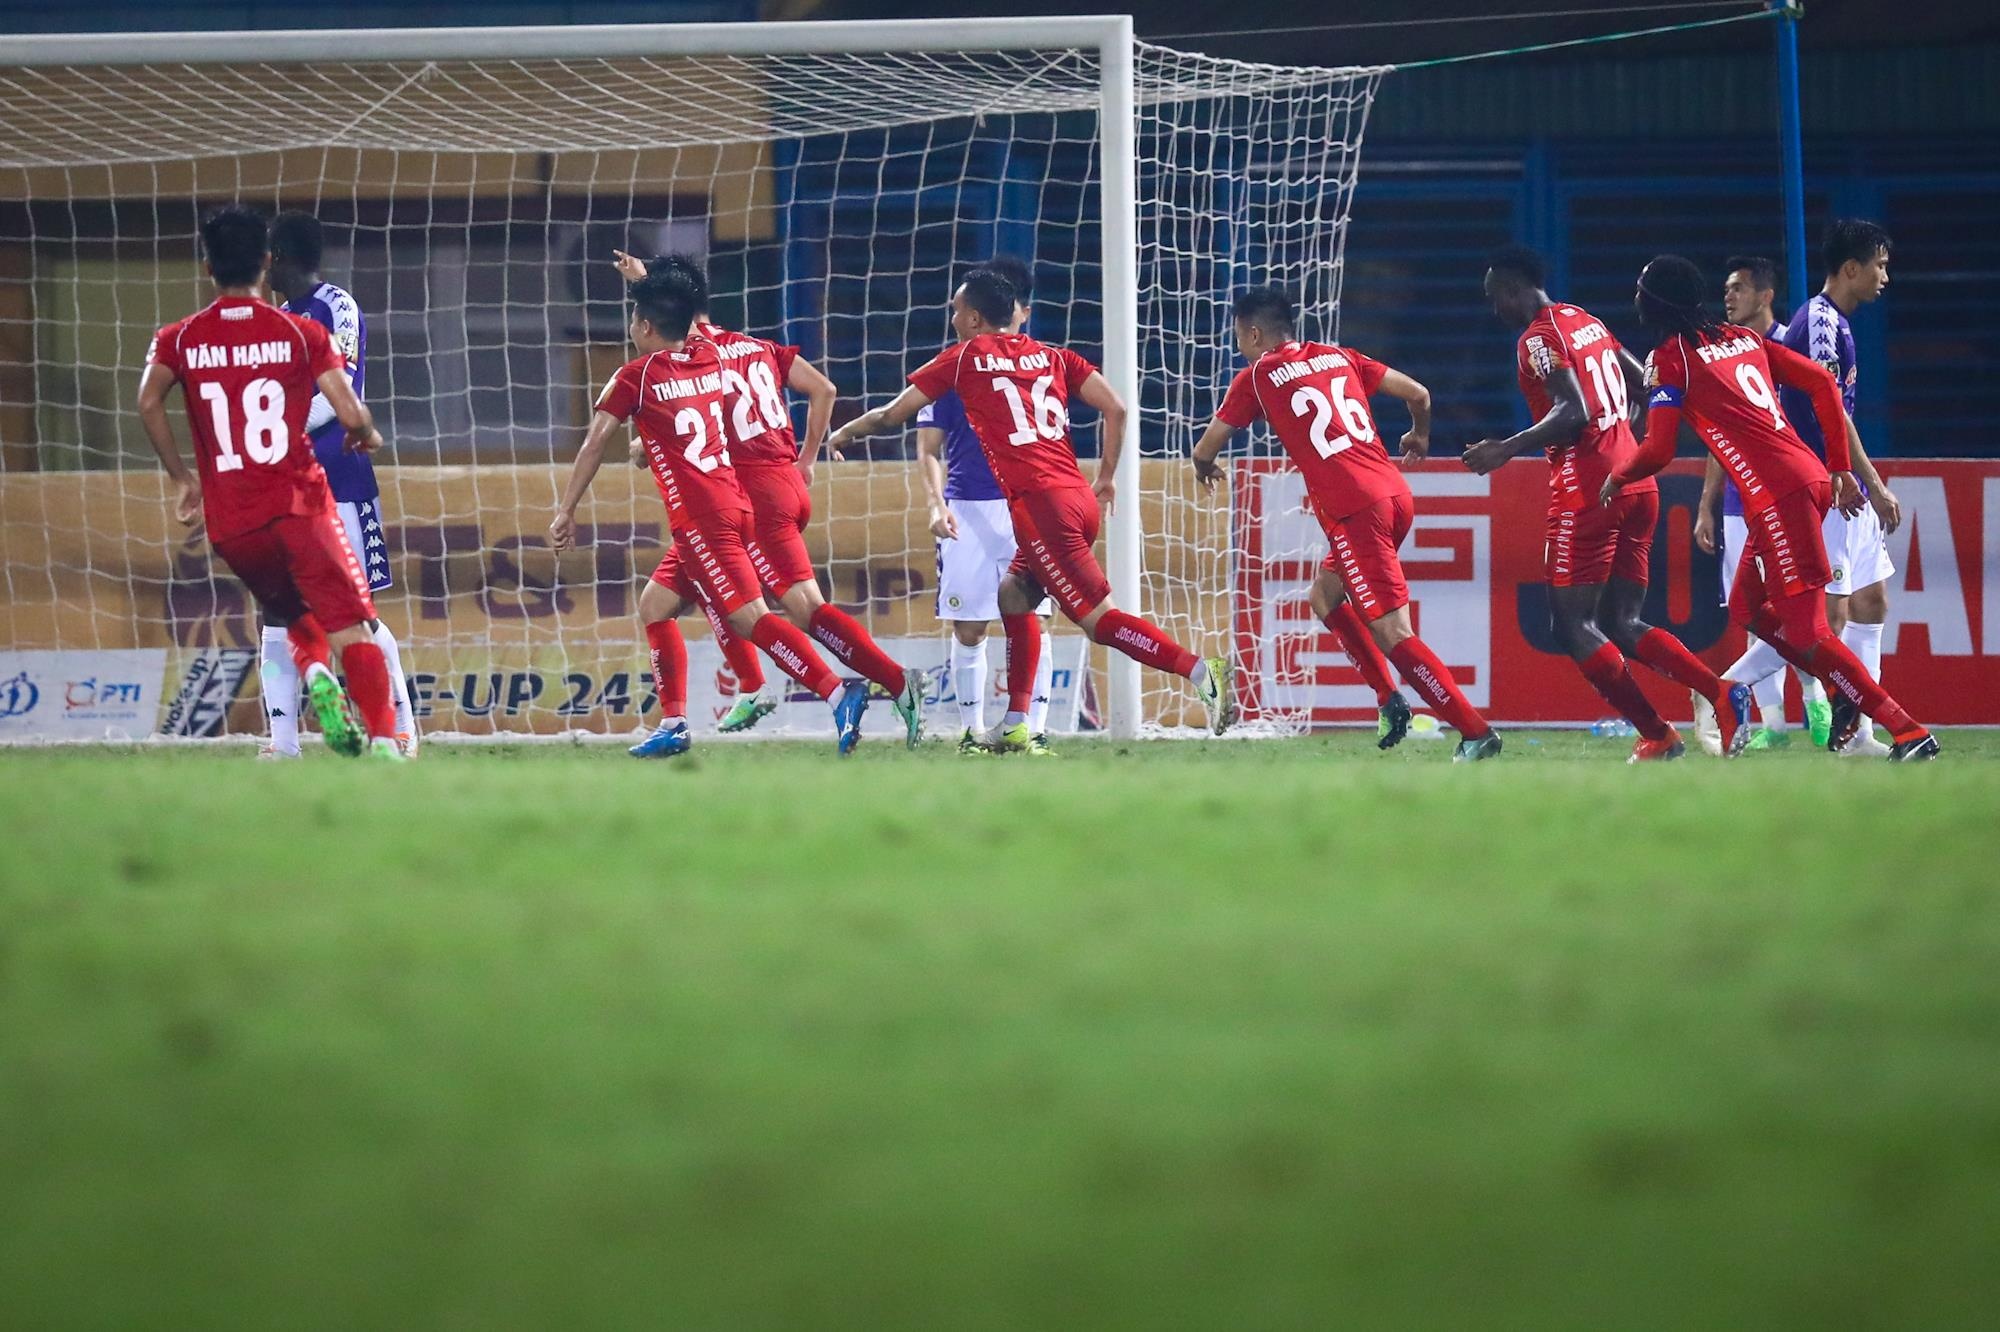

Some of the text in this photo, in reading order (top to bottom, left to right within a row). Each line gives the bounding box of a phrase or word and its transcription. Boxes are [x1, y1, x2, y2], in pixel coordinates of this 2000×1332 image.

[185, 341, 292, 370] VĂN HẠNH
[973, 353, 1016, 372] LÂM
[1268, 360, 1312, 388] HOÀNG
[1696, 335, 1760, 364] FAGAN
[651, 371, 722, 401] THÀNH LONG
[722, 361, 787, 442] 28
[991, 375, 1066, 447] 16
[1290, 375, 1375, 460] 26
[1585, 348, 1627, 431] 10
[1735, 362, 1786, 431] 9
[200, 378, 289, 472] 18
[674, 400, 732, 473] 21
[1706, 425, 1763, 496] JOGARBOLA
[384, 523, 662, 620] T&T
[686, 529, 737, 601] JOGARBOLA
[746, 541, 781, 589] ARBOLA
[1030, 539, 1083, 609] JOGARBOLA
[1333, 534, 1376, 609] JOGARBOLA
[1761, 505, 1798, 584] JOGARBOLA
[770, 639, 809, 678] JOGARBOLA
[1114, 626, 1160, 655] JOGARBOLA
[100, 683, 141, 702] PTI
[1413, 664, 1451, 706] JOGARBOLA
[1829, 669, 1864, 706] JOGARBOLA
